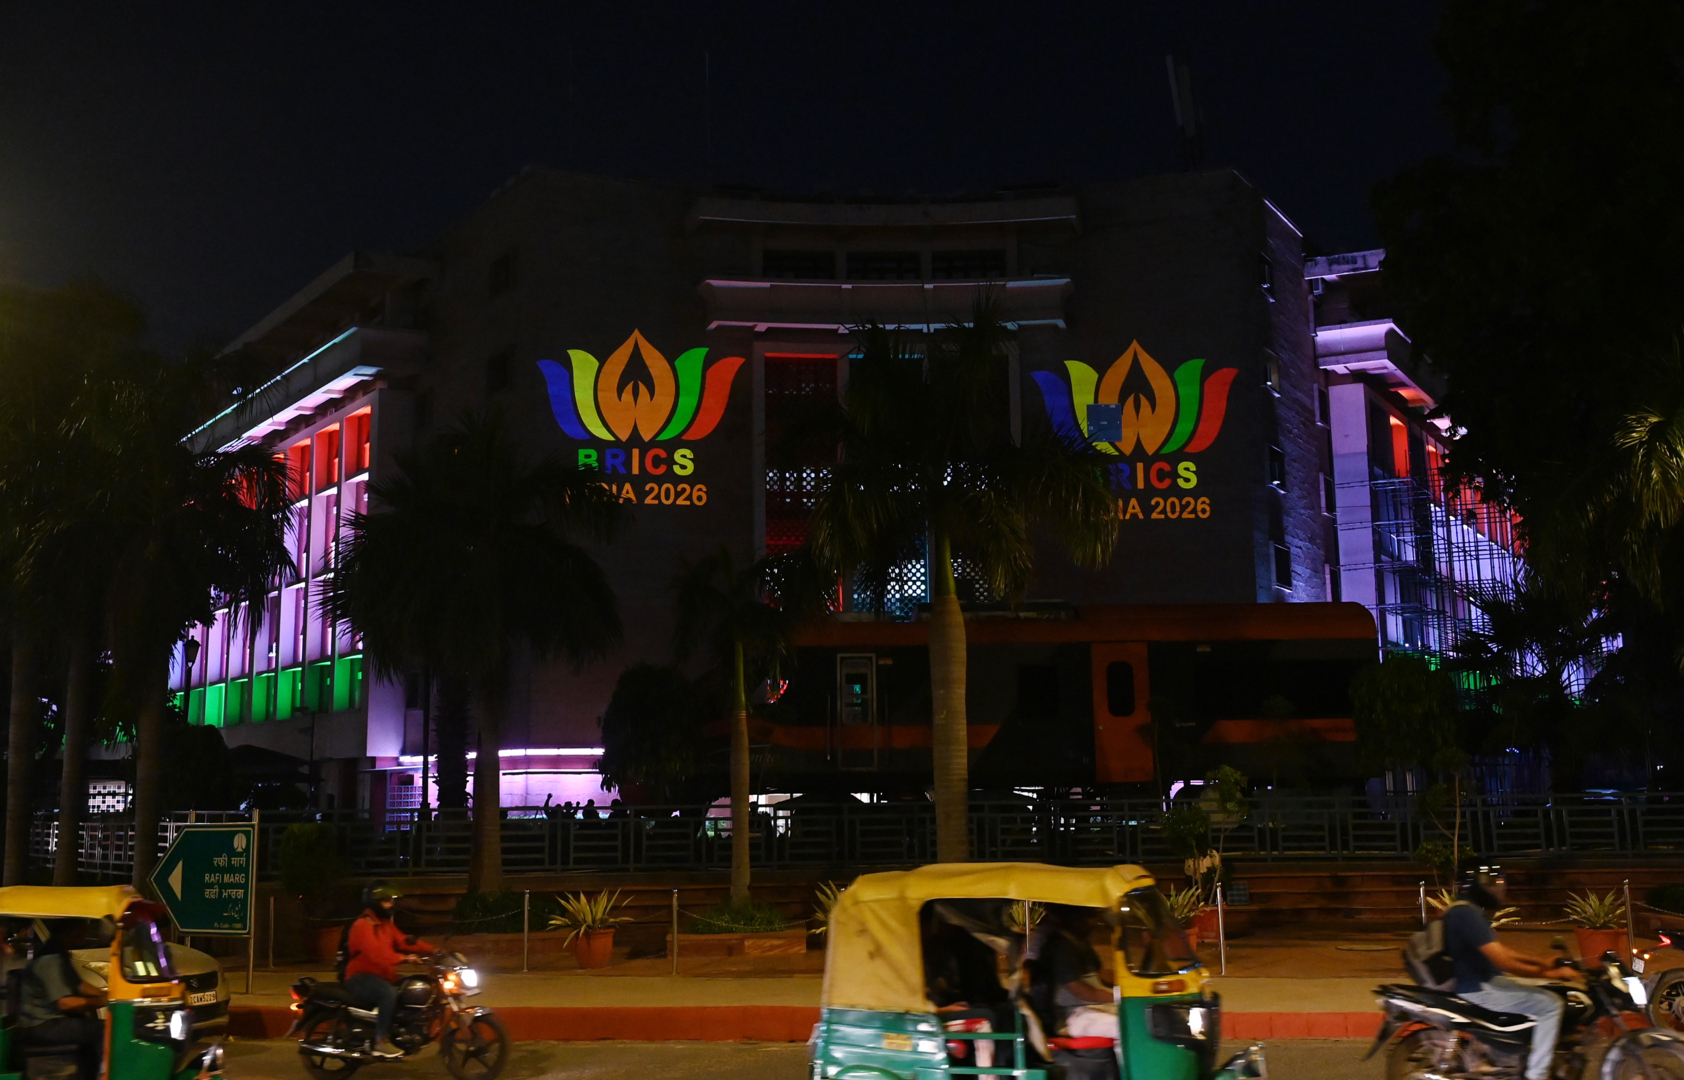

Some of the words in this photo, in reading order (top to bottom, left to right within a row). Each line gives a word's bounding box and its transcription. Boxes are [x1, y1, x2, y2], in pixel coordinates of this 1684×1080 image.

[577, 447, 695, 476] BRICS
[1095, 460, 1198, 490] RICS
[644, 482, 708, 506] 2026
[1150, 496, 1212, 519] 2026
[231, 853, 246, 867] मार्ग
[204, 873, 222, 883] RAFI
[224, 873, 245, 883] MARG
